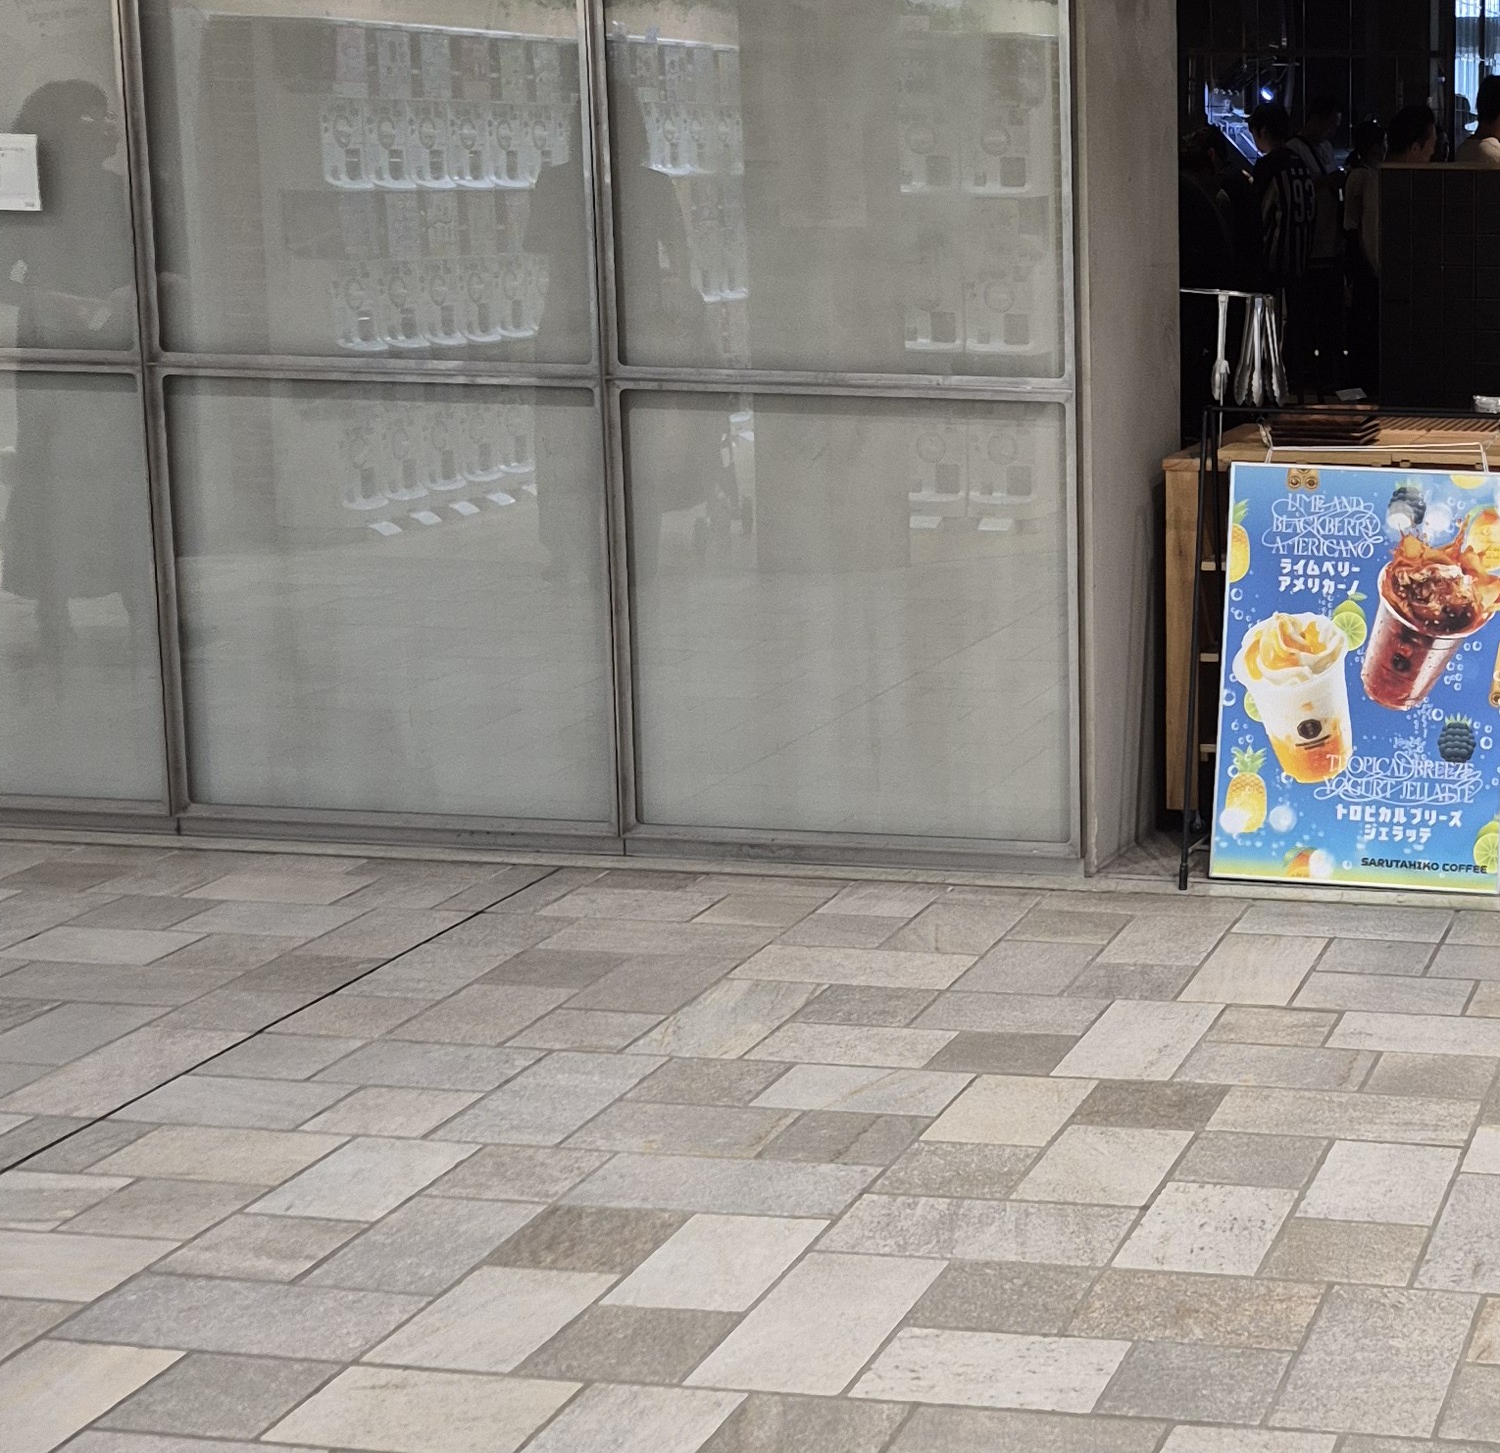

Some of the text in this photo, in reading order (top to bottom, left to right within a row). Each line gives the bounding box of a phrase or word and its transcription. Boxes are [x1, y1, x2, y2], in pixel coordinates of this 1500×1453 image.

[1272, 514, 1379, 537] BLACKBERRY
[1280, 558, 1360, 577] ライムベリー
[1278, 576, 1360, 596] アメリカーノ
[1363, 824, 1432, 844] ジェラッテ
[1361, 857, 1488, 874] SARUTAHIKO COFFEE
